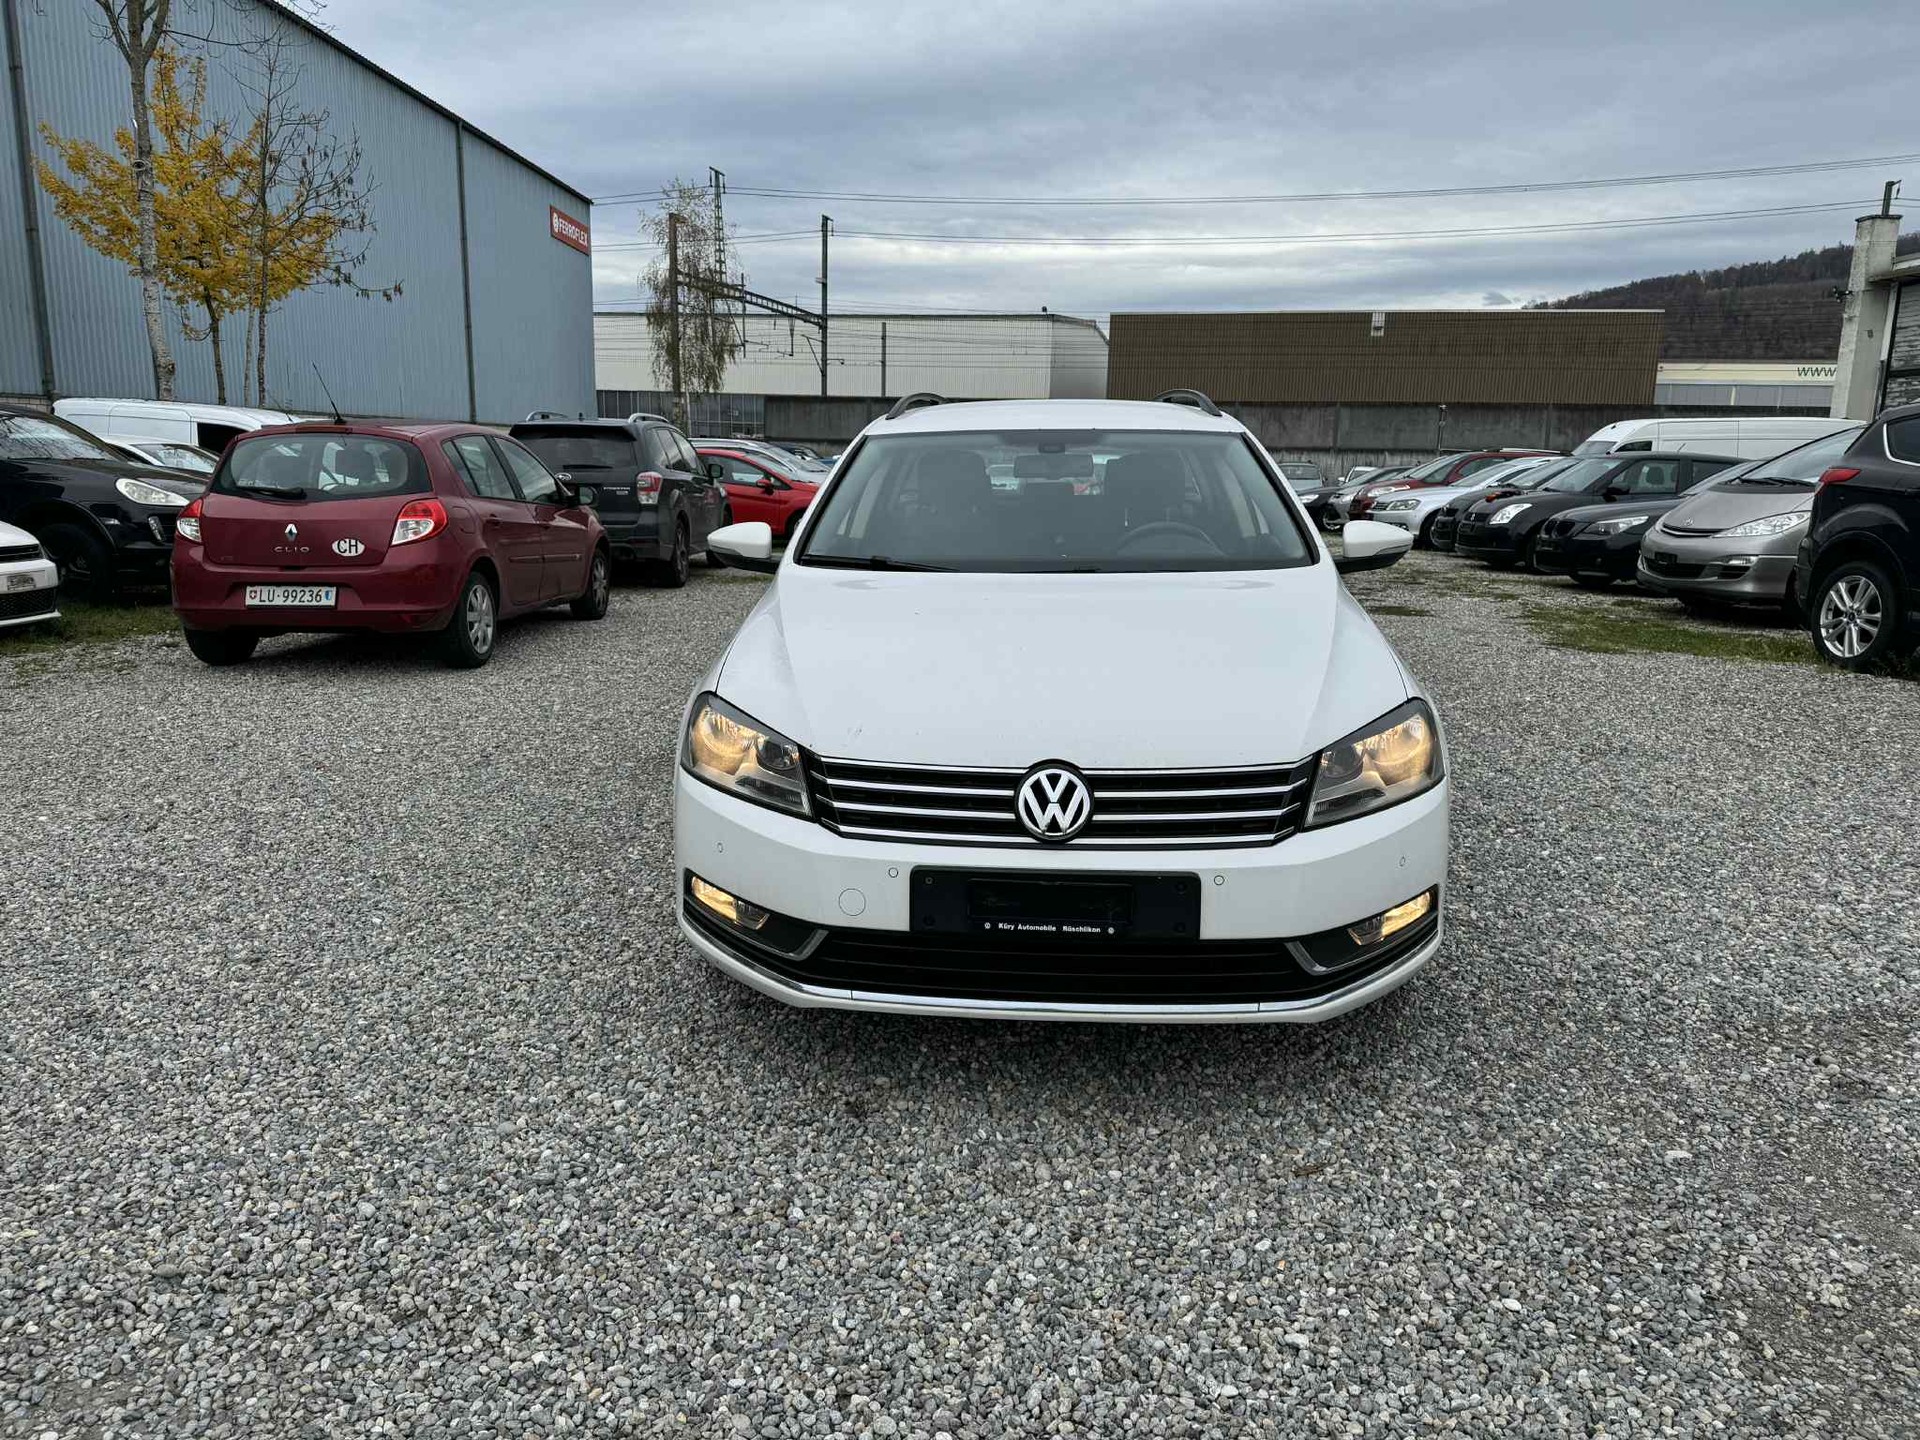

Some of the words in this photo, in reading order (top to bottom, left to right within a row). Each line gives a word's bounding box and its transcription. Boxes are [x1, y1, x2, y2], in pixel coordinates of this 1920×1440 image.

[559, 217, 588, 247] FERROFLEX
[337, 539, 358, 554] CH
[1018, 768, 1090, 836] VW
[1017, 923, 1057, 932] Automobile
